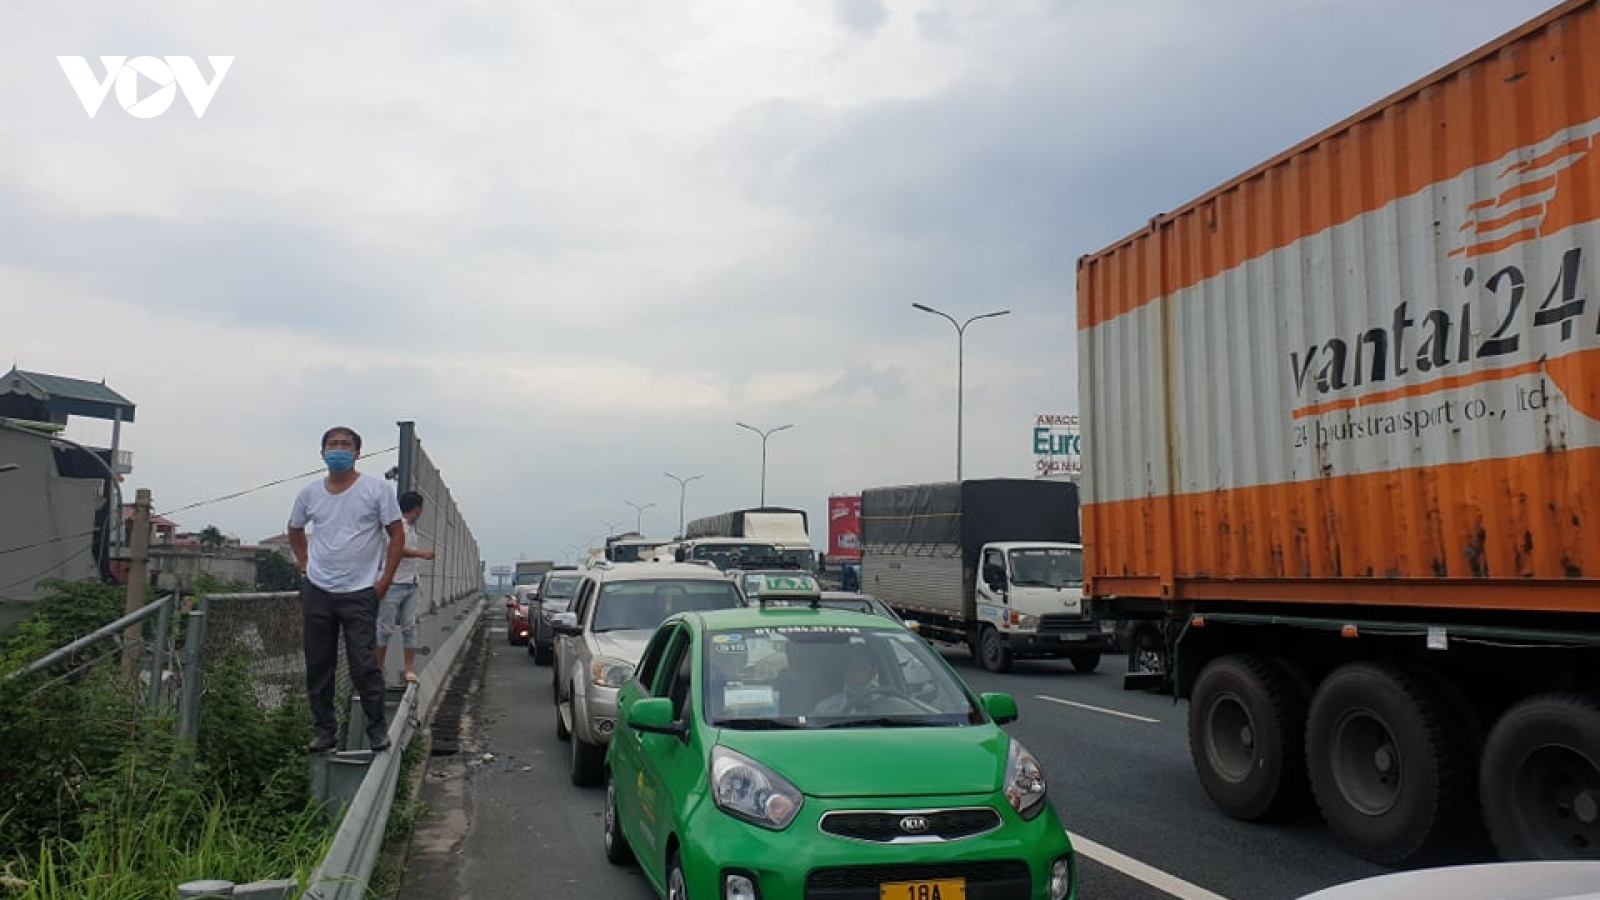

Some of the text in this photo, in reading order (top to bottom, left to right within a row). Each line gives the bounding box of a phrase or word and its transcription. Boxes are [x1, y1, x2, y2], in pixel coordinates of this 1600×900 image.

[1291, 248, 1600, 397] vantai24
[902, 818, 929, 831] KIA
[908, 884, 942, 900] 18A
